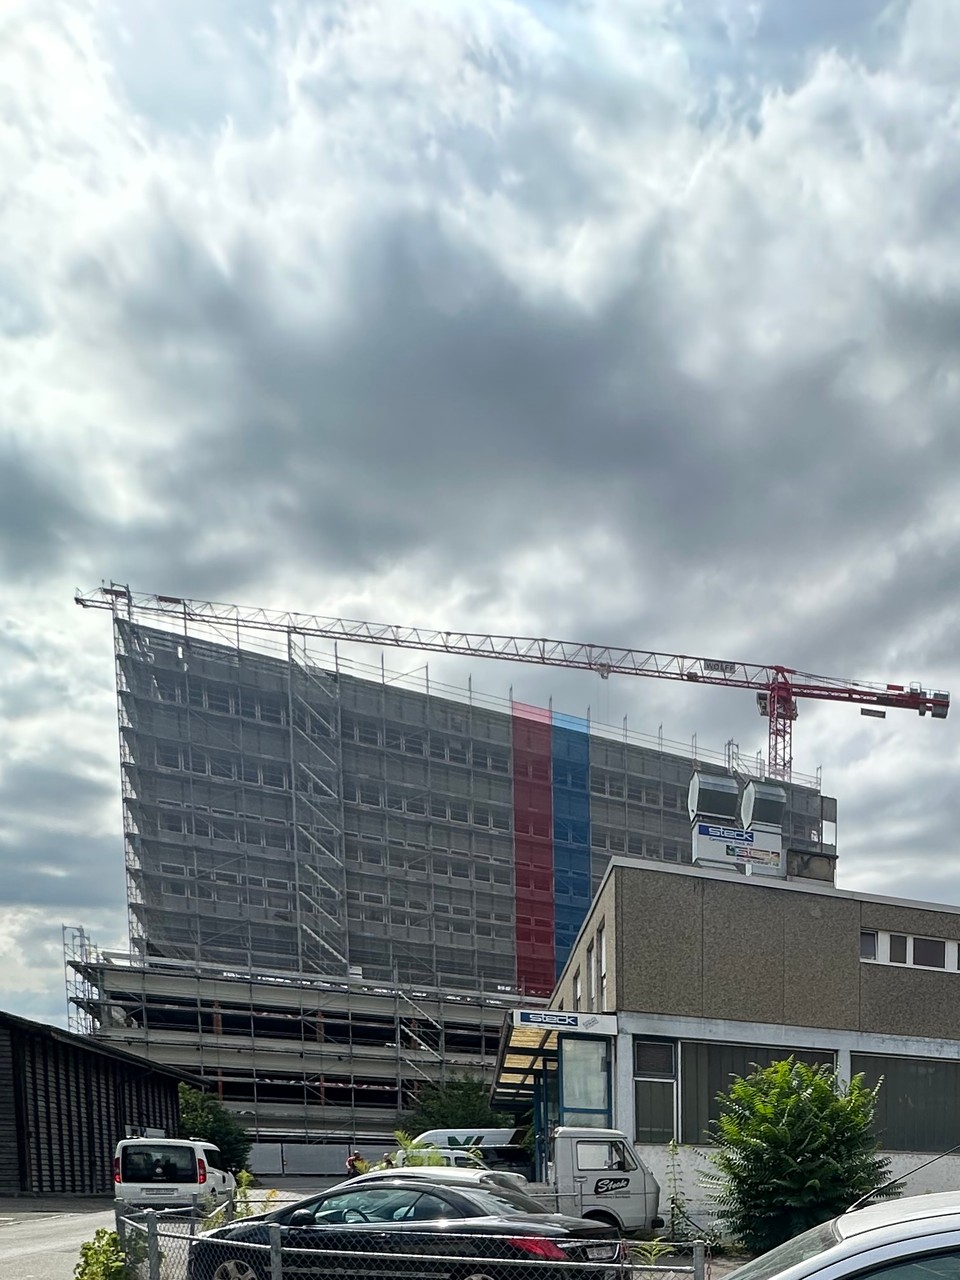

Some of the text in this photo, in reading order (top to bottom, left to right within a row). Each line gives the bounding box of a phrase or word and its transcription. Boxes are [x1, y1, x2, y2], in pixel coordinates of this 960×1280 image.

[706, 662, 735, 672] WOLFF
[708, 825, 753, 841] steck
[529, 1013, 576, 1025] steck
